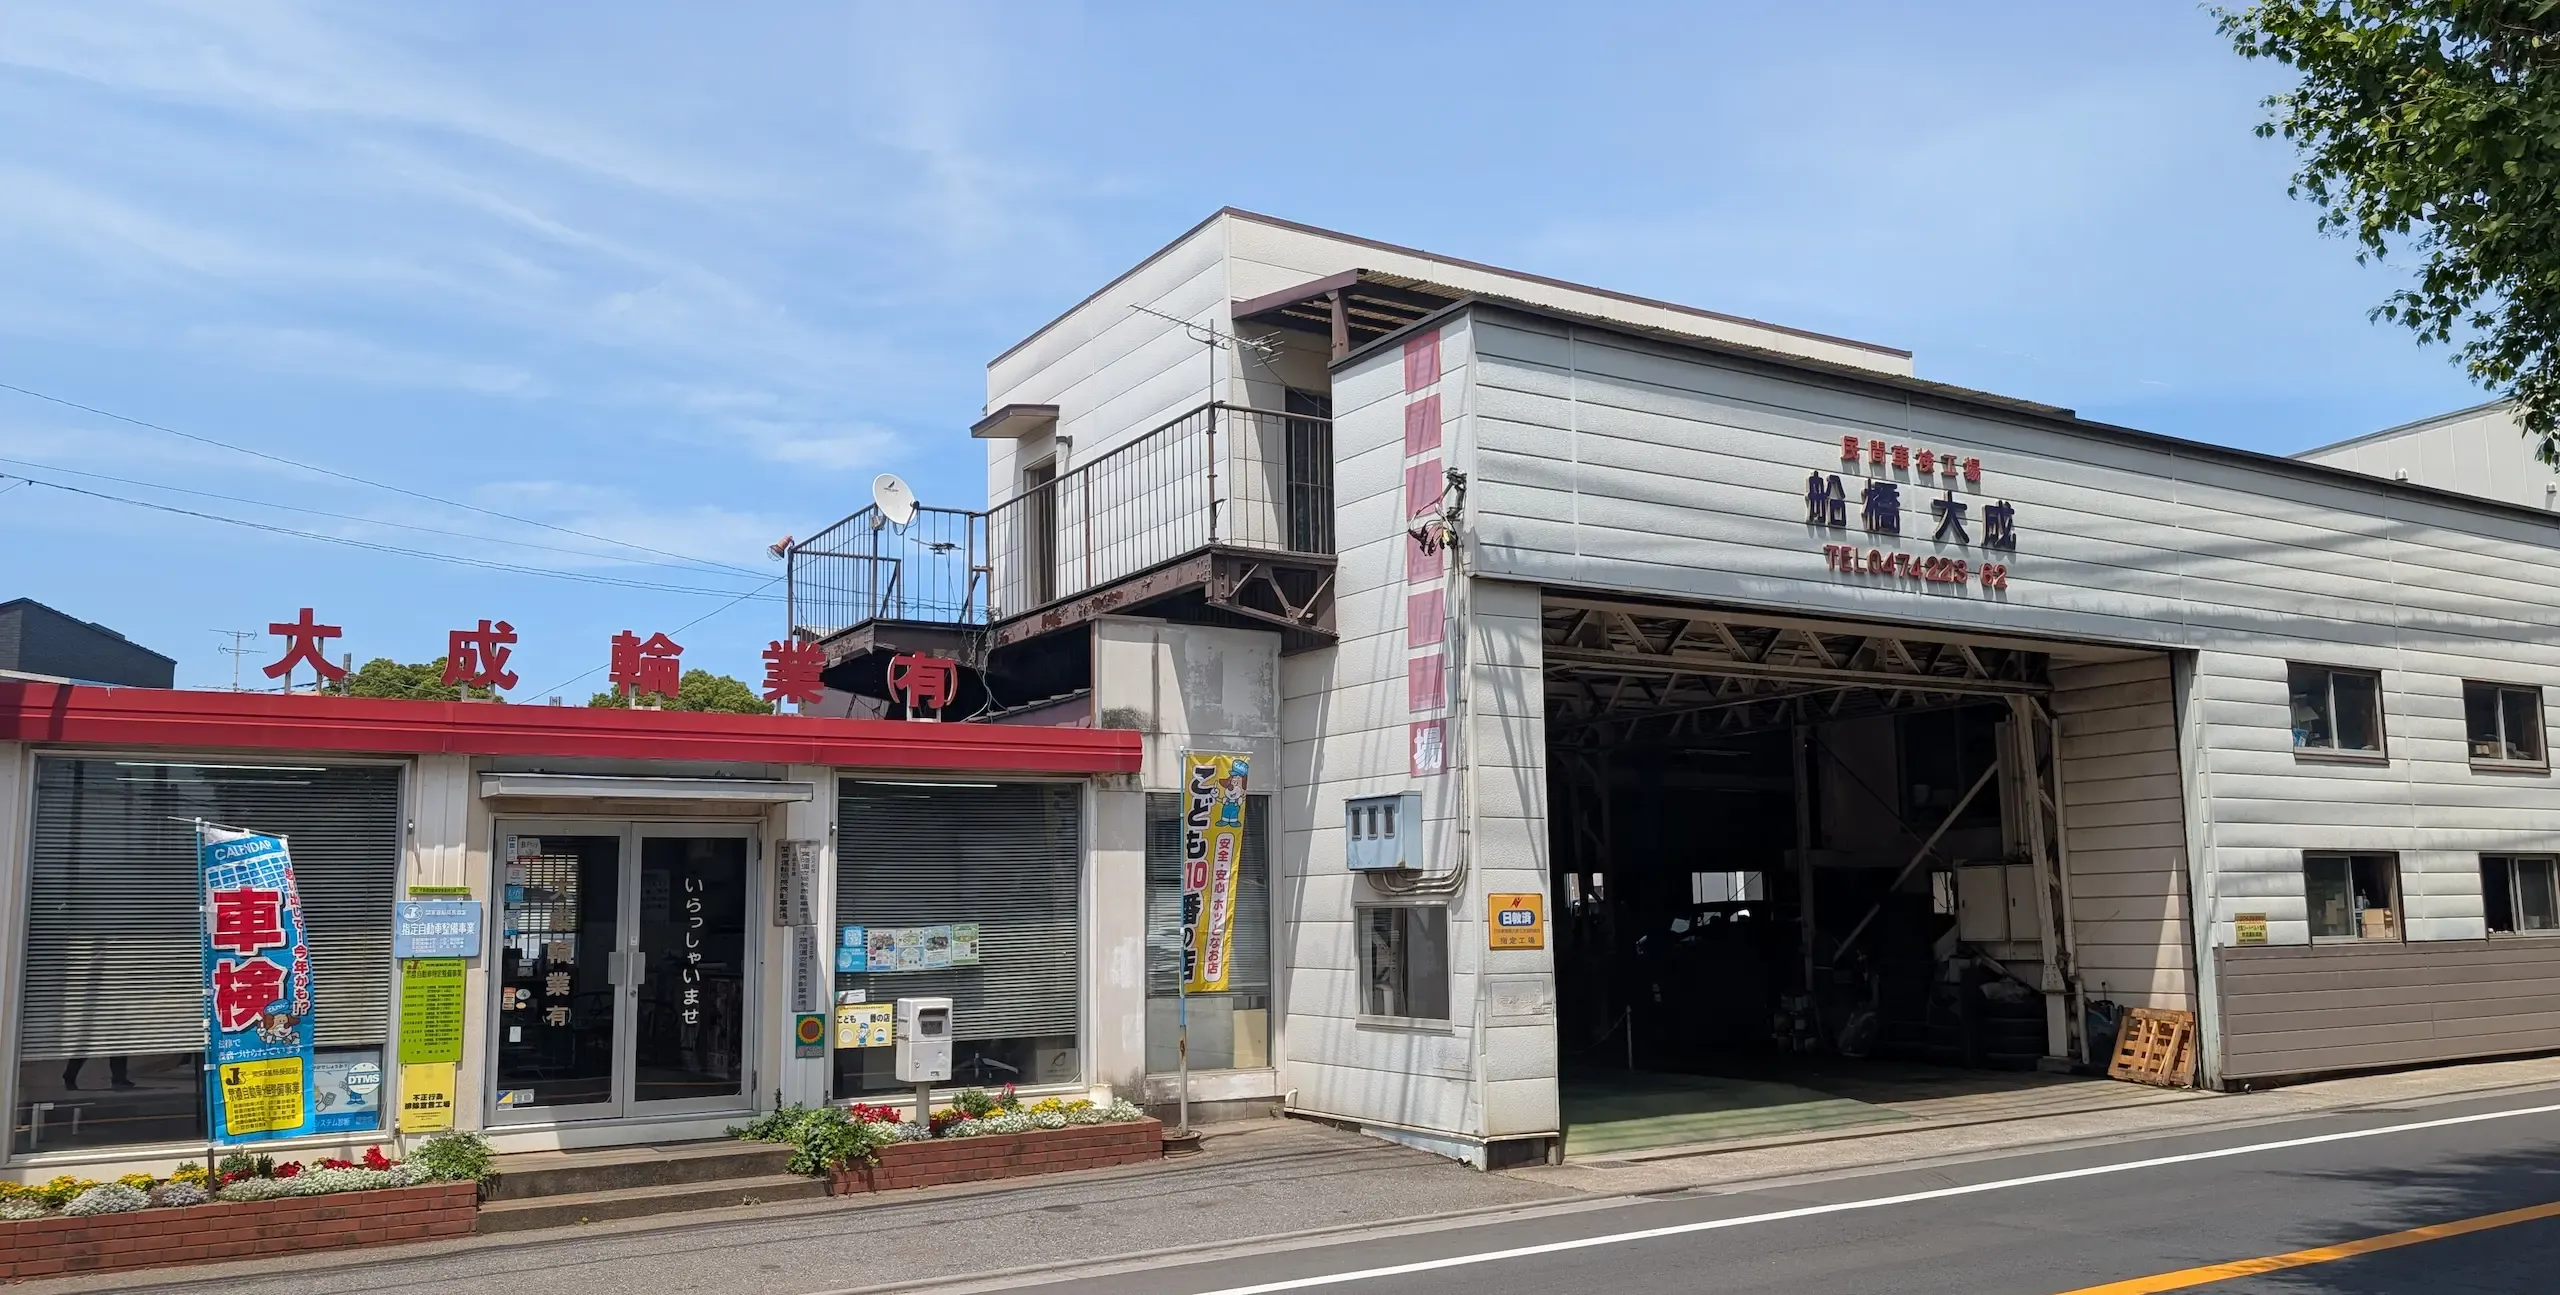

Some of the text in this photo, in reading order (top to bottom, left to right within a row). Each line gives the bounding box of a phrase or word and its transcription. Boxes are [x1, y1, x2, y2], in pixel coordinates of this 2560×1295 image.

[1840, 435, 1981, 483] 民間車検工場
[1979, 562, 2008, 590] 62
[214, 839, 273, 861] CALENDAR
[1183, 765, 1216, 981] こども10番の店
[401, 922, 476, 936] 指定自動車整備事業
[213, 886, 286, 1029] 車検
[682, 877, 704, 1025] いらっしゃいませ
[836, 1014, 857, 1024] こども
[348, 1073, 380, 1085] DTMS
